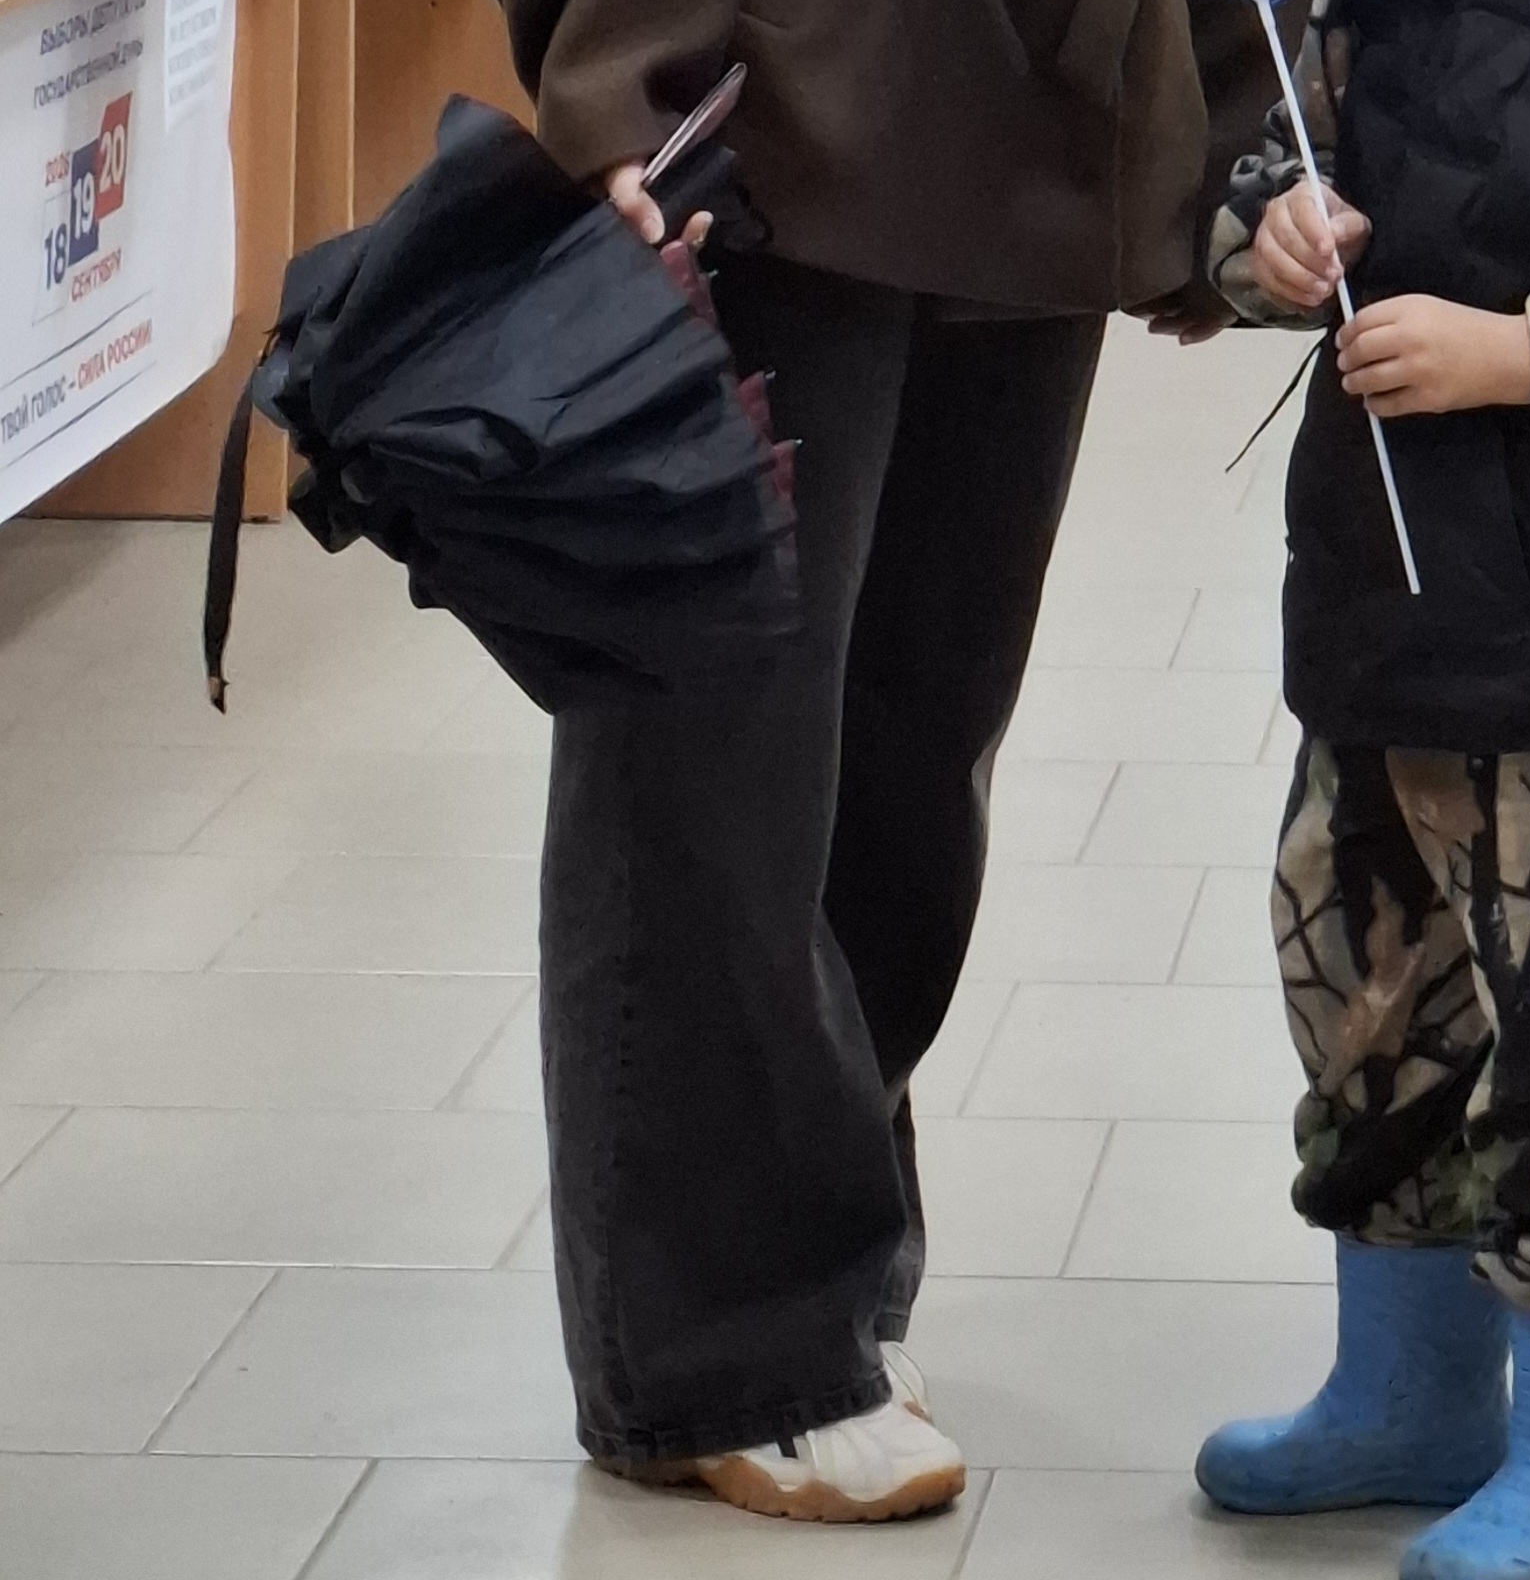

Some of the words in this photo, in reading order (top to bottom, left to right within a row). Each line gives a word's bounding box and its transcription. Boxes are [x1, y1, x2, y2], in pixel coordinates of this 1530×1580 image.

[45, 223, 67, 290] 18
[74, 172, 95, 240] 19
[100, 123, 125, 194] 20
